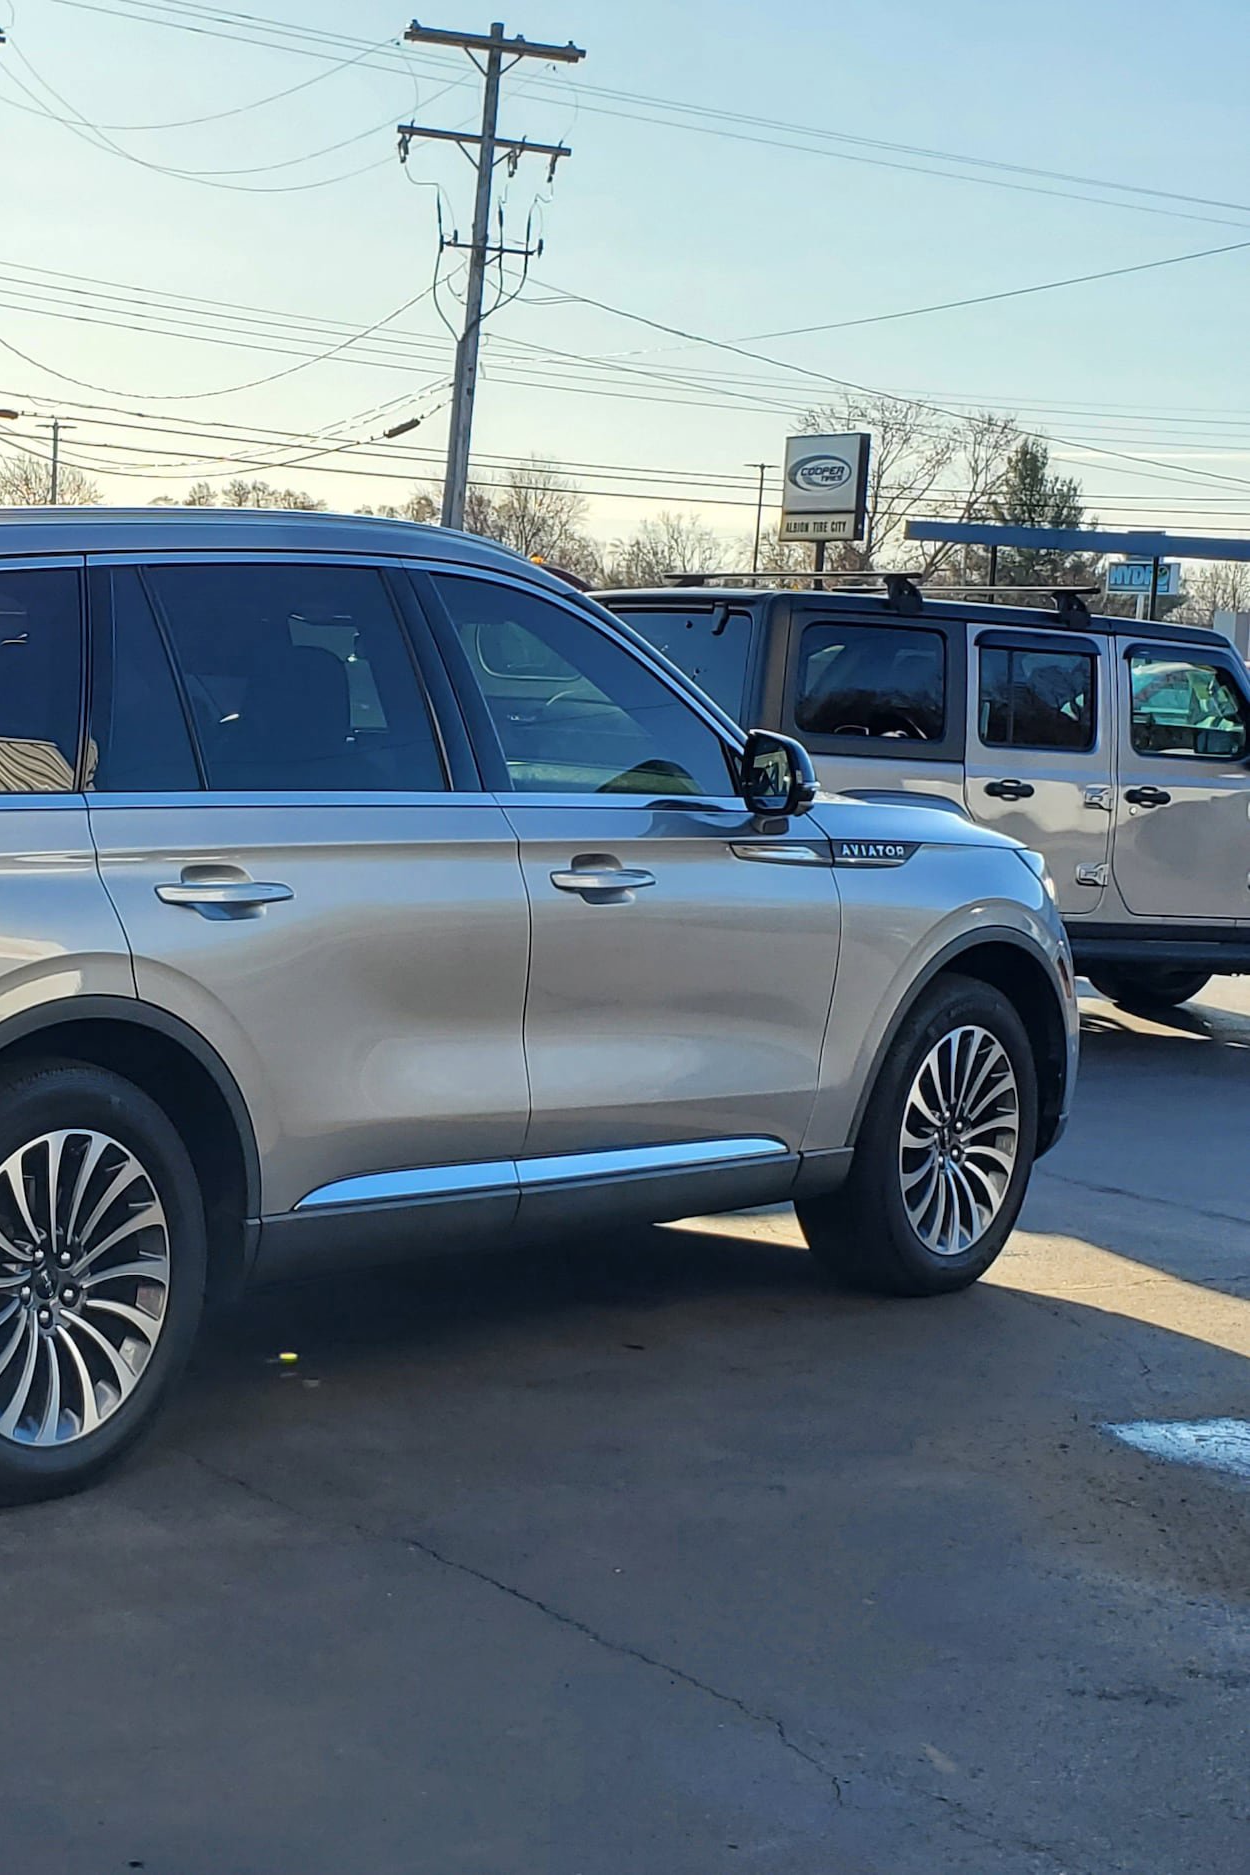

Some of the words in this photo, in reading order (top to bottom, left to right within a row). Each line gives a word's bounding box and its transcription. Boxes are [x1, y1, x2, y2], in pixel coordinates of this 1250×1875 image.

[801, 466, 844, 476] COOPER
[786, 522, 809, 533] ALBION
[813, 522, 828, 533] TIRE
[831, 522, 846, 533] CITY
[842, 844, 905, 856] AVIATOR
